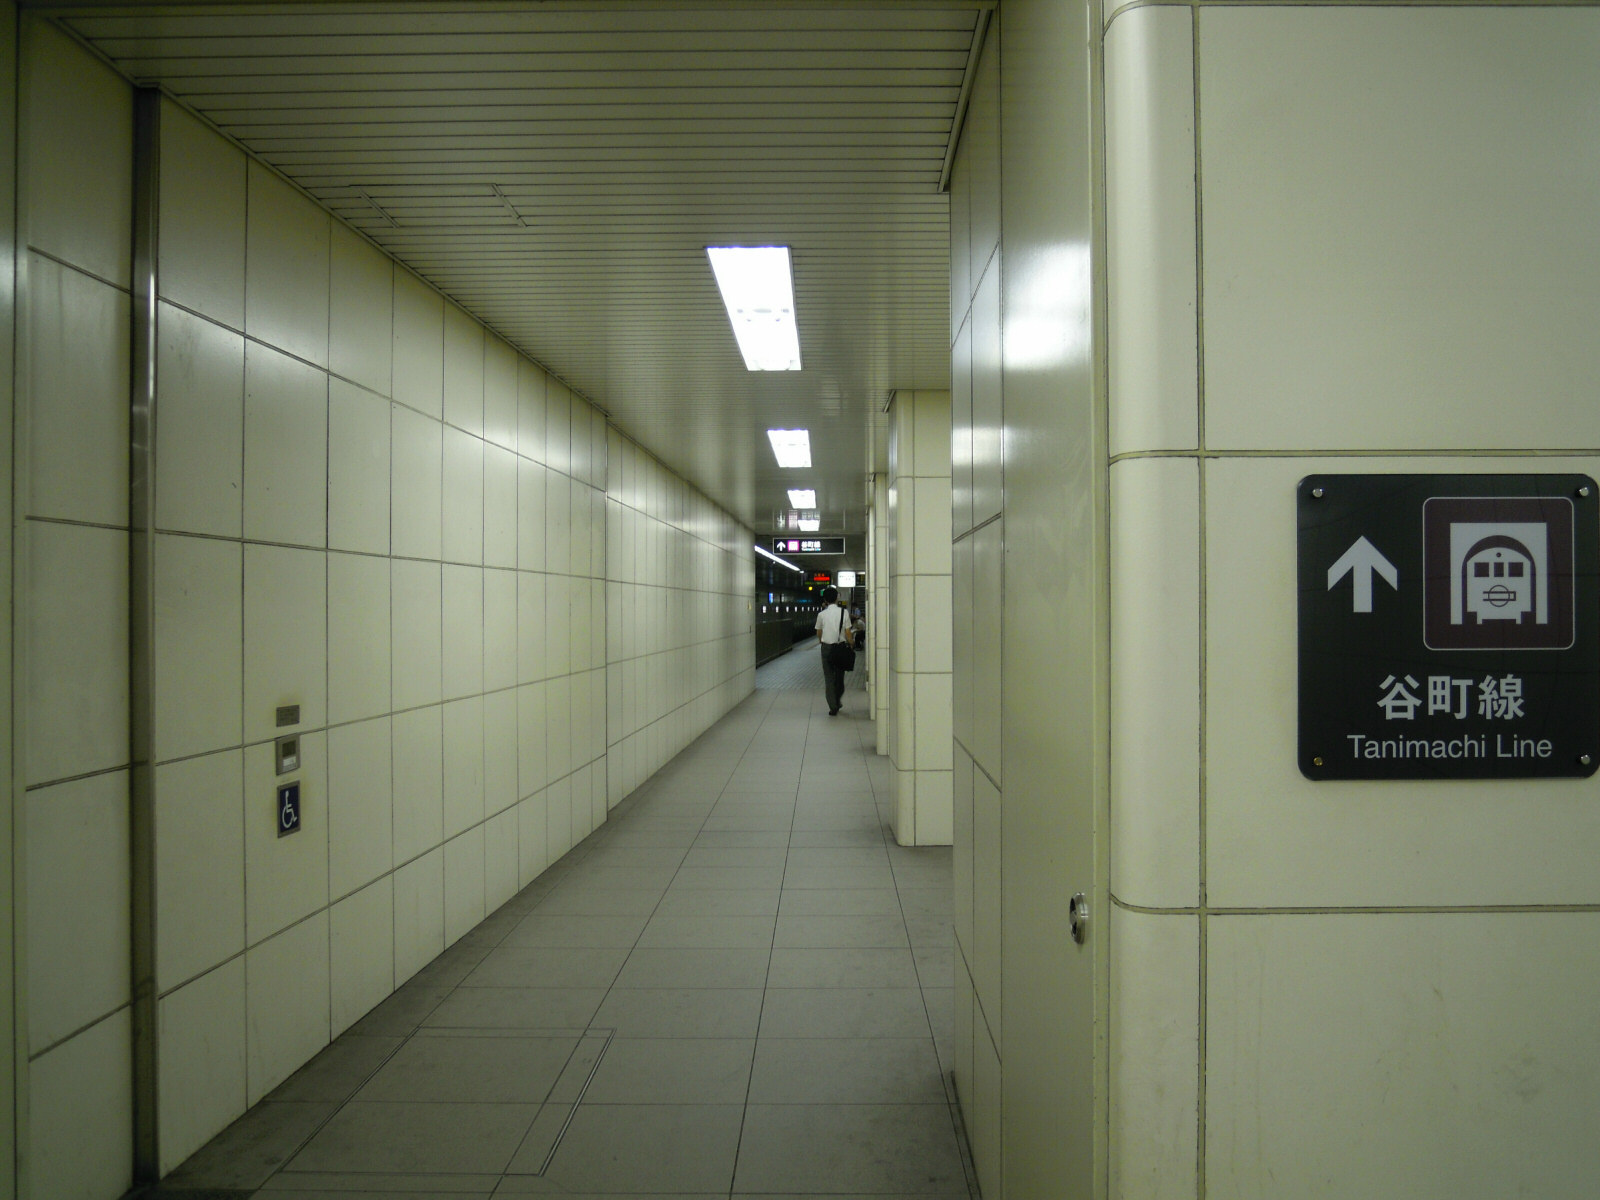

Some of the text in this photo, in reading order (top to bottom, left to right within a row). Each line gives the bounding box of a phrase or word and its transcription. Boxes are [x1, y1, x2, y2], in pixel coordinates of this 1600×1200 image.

[1376, 674, 1525, 720] 谷町線
[1346, 734, 1552, 759] Tanimachi Line
